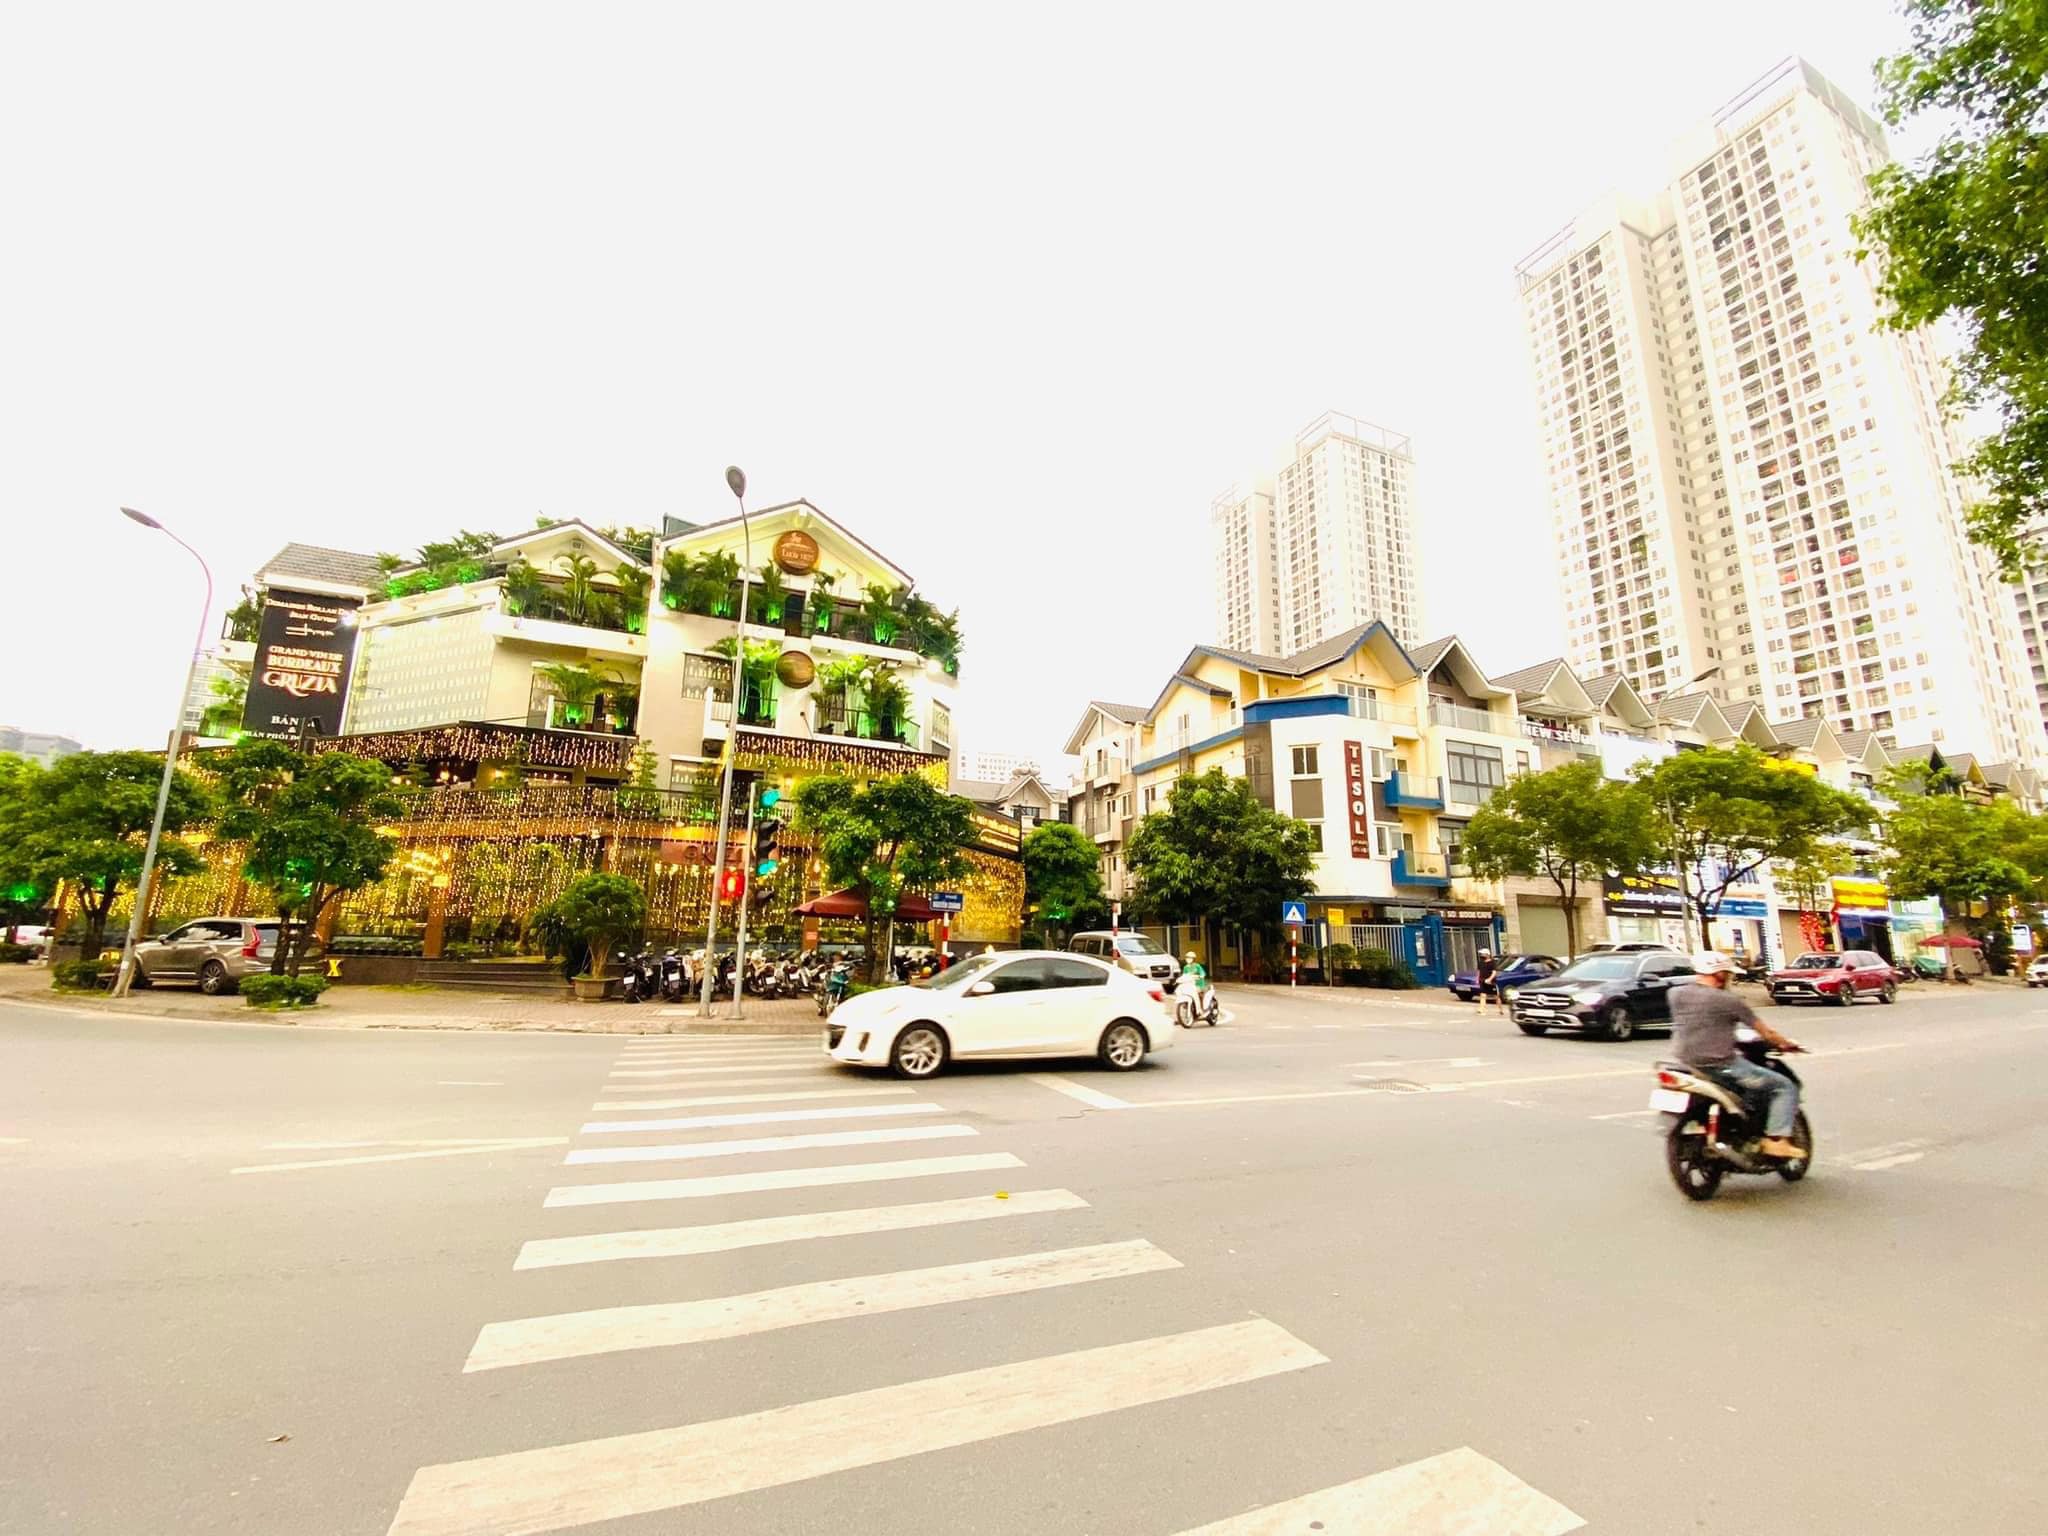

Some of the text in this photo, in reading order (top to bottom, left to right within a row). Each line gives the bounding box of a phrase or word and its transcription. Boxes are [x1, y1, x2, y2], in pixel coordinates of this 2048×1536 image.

[269, 646, 308, 656] GRAND
[268, 655, 342, 673] BORDEAUX
[263, 671, 337, 697] GRUZIA
[1521, 723, 1552, 739] NEW
[1349, 745, 1365, 835] TESOL
